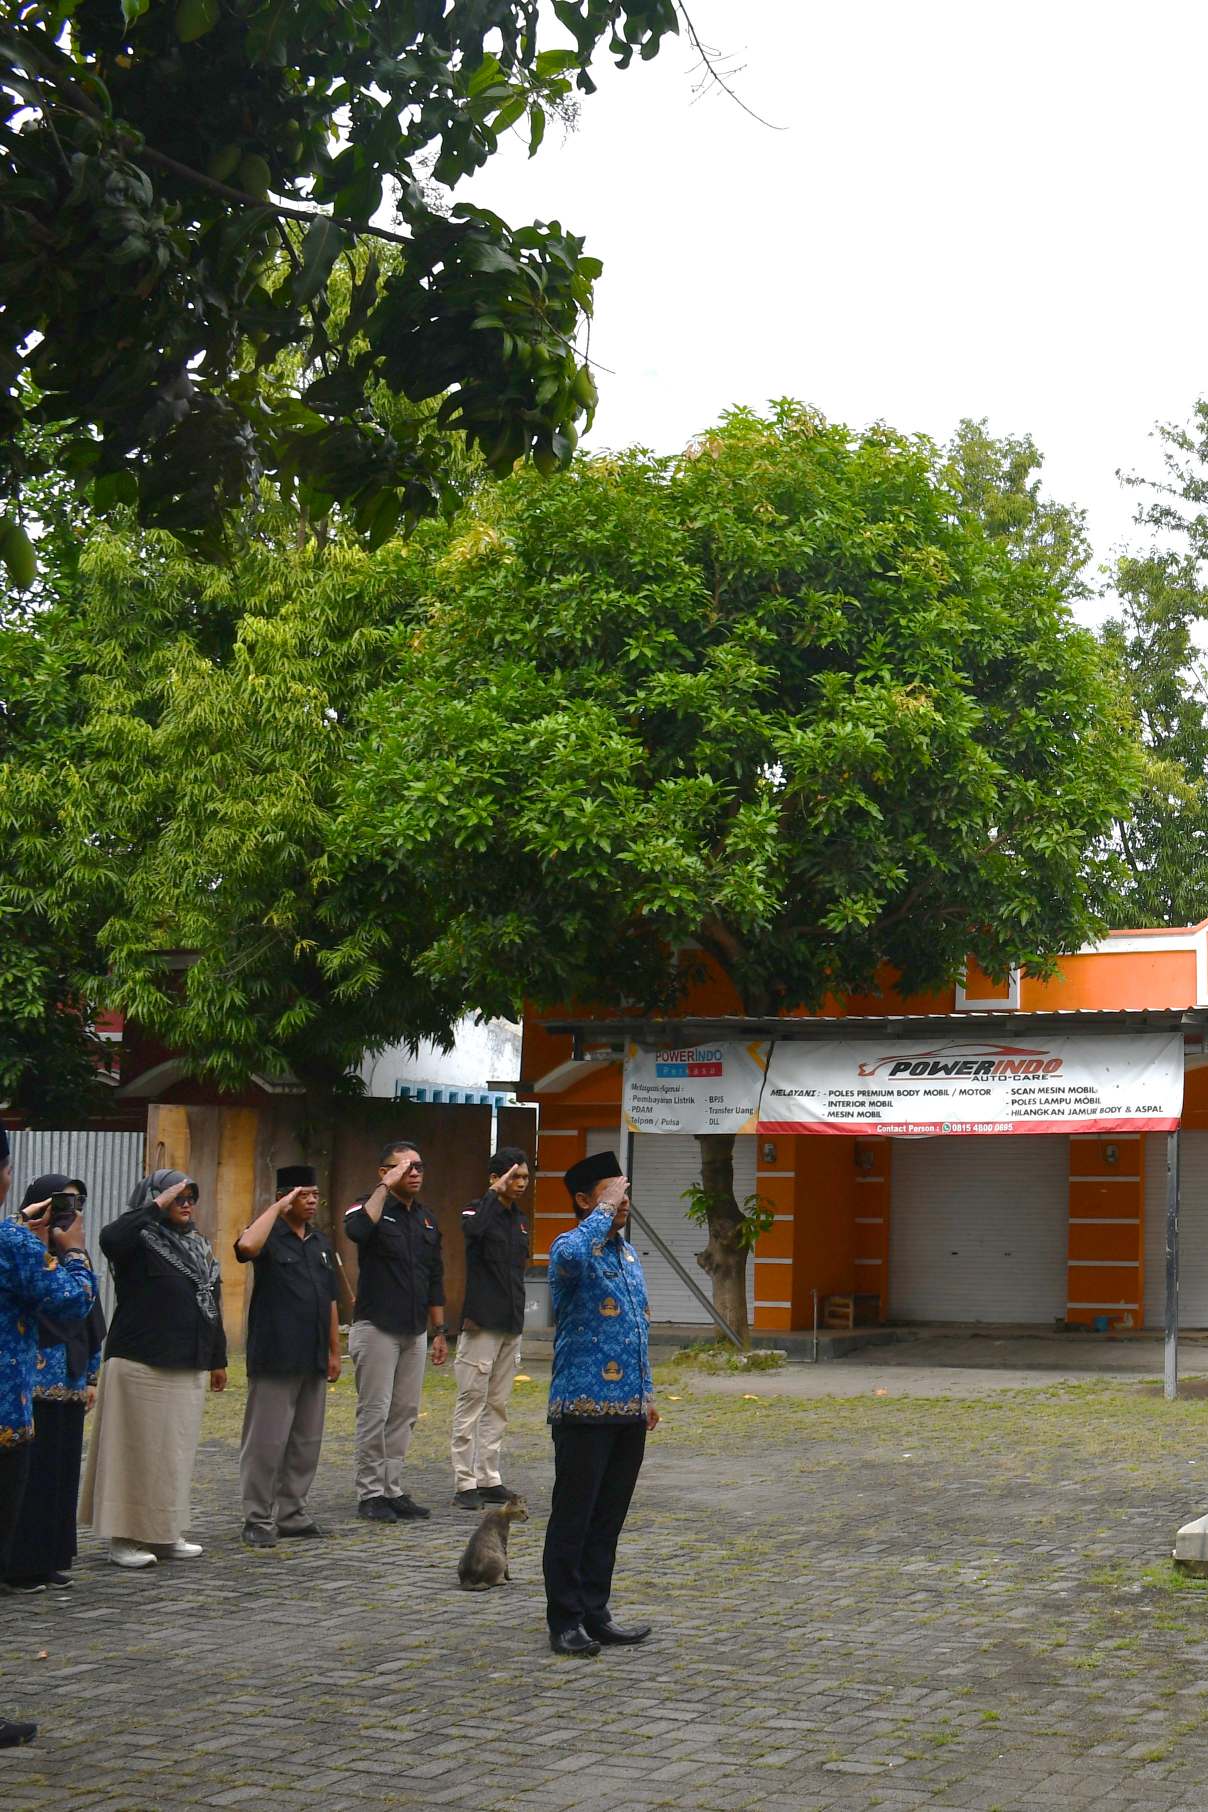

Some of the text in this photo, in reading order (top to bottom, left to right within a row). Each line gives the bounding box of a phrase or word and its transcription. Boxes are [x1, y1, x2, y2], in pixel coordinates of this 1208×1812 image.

[656, 1048, 722, 1062] POWERINDO
[889, 1058, 1064, 1077] POWERINDO
[971, 1073, 1049, 1082] AUTO-CARE
[828, 1089, 855, 1097] POLES
[856, 1089, 895, 1097] PREMIUM
[896, 1088, 921, 1097] BODY
[923, 1089, 950, 1097] MOBIL
[958, 1088, 992, 1096] MOTOR
[1011, 1086, 1097, 1096] SCAN MESIN MOBIL
[673, 1096, 696, 1105] Listrik
[1011, 1096, 1102, 1106] POLES LAMPU MOBIL
[631, 1105, 654, 1114] PDAM
[708, 1106, 754, 1116] Transfer Uang
[1011, 1105, 1164, 1117] HILANGKAN JAMUR BODY & ASPAL
[708, 1117, 720, 1126] DLL
[952, 1124, 971, 1132] 0815
